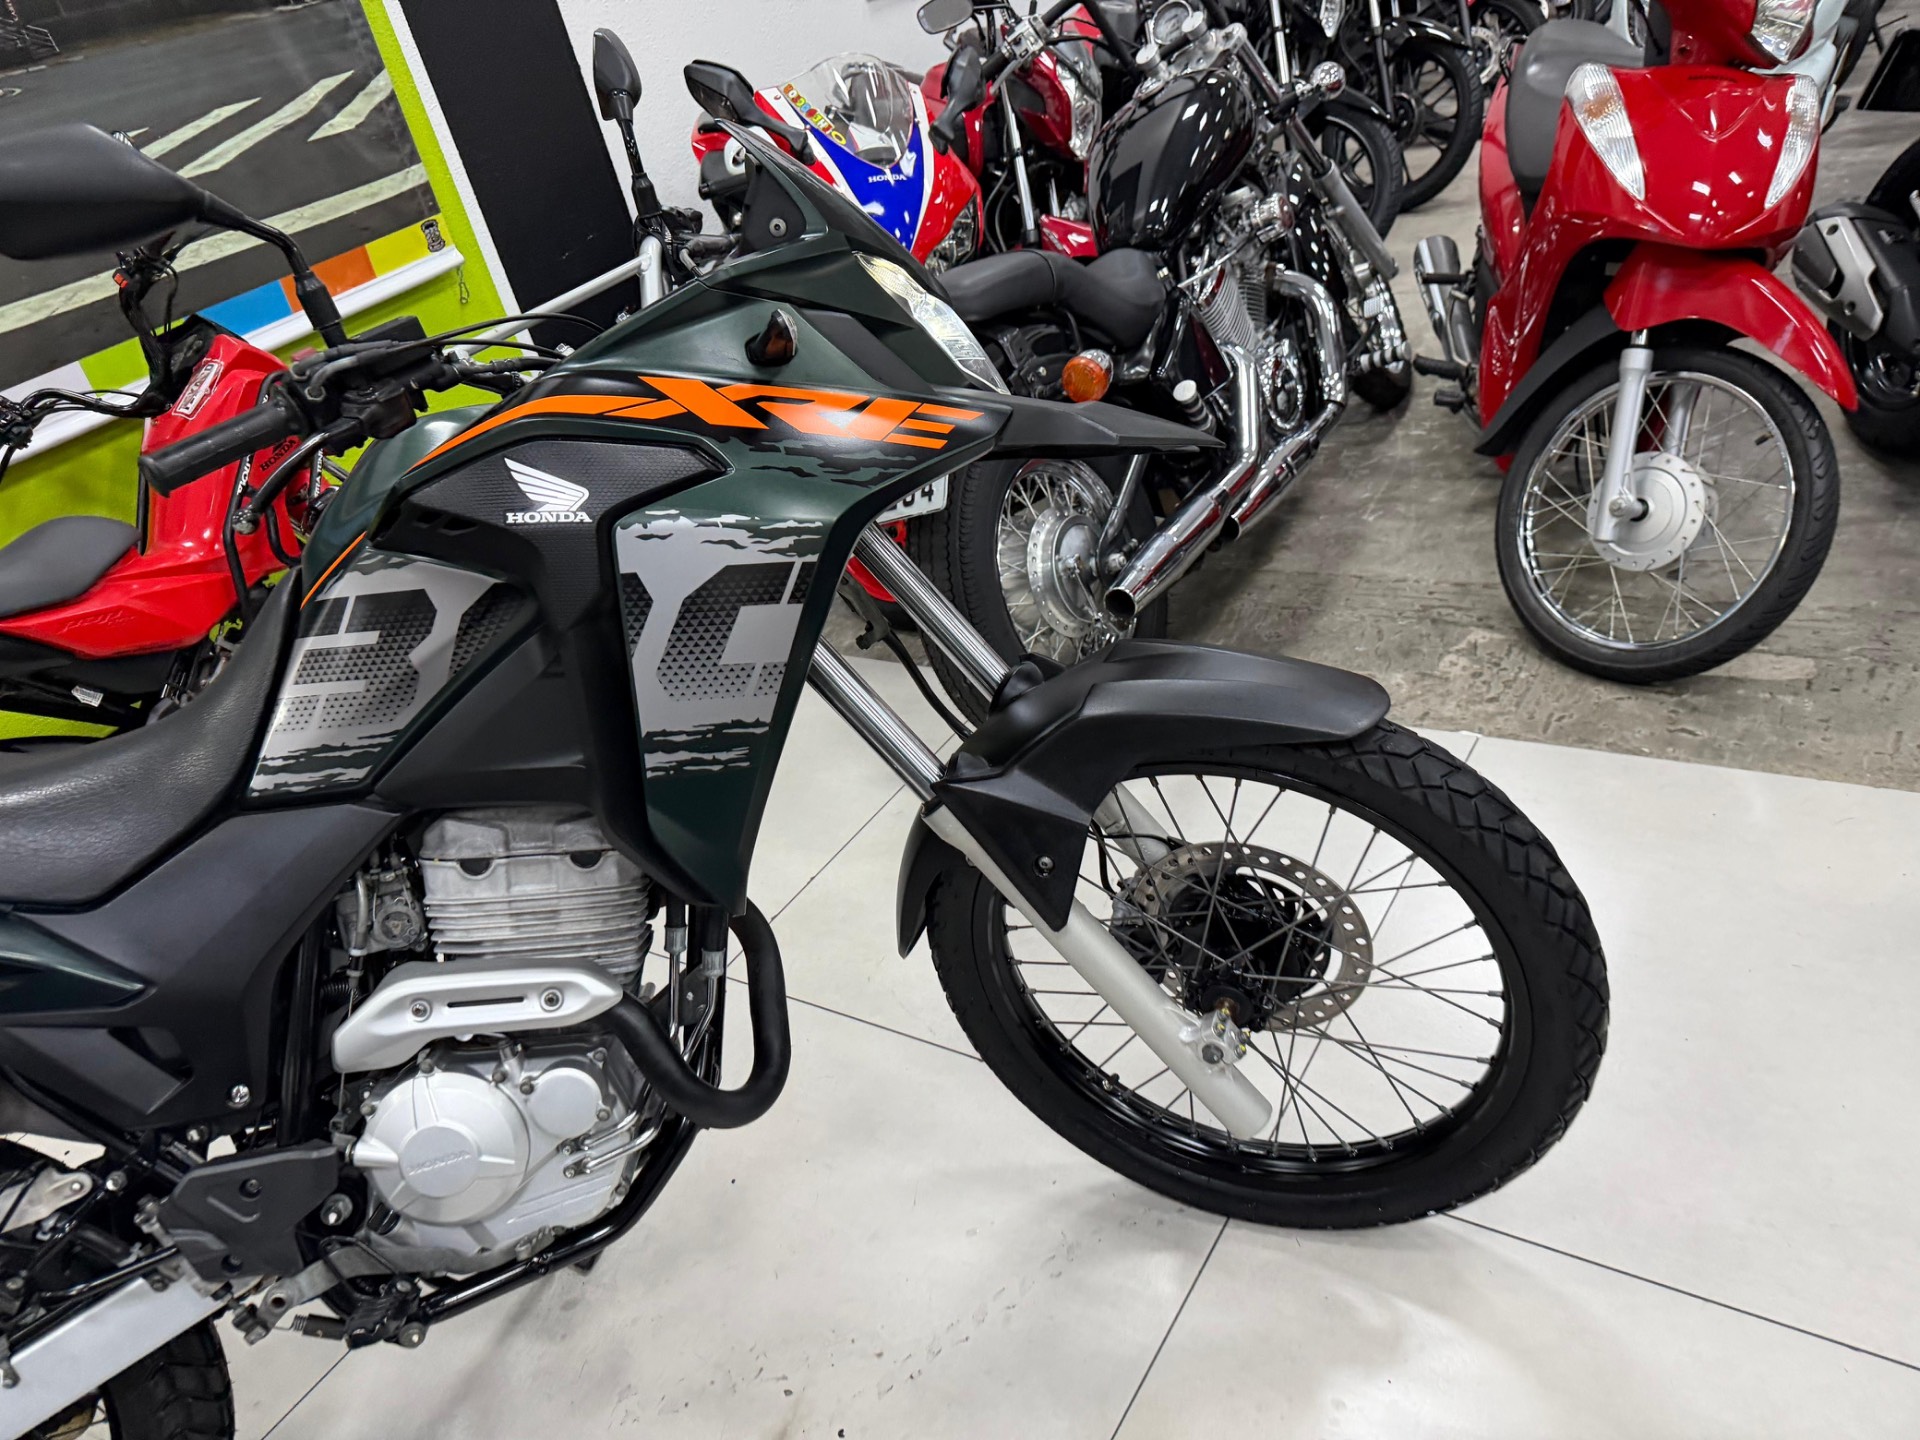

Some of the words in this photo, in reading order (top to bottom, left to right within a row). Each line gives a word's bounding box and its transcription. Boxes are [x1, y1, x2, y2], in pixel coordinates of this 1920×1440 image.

[868, 174, 908, 184] HONDA
[606, 376, 984, 450] XRE
[260, 440, 297, 471] HONDA
[506, 511, 593, 524] HONDA
